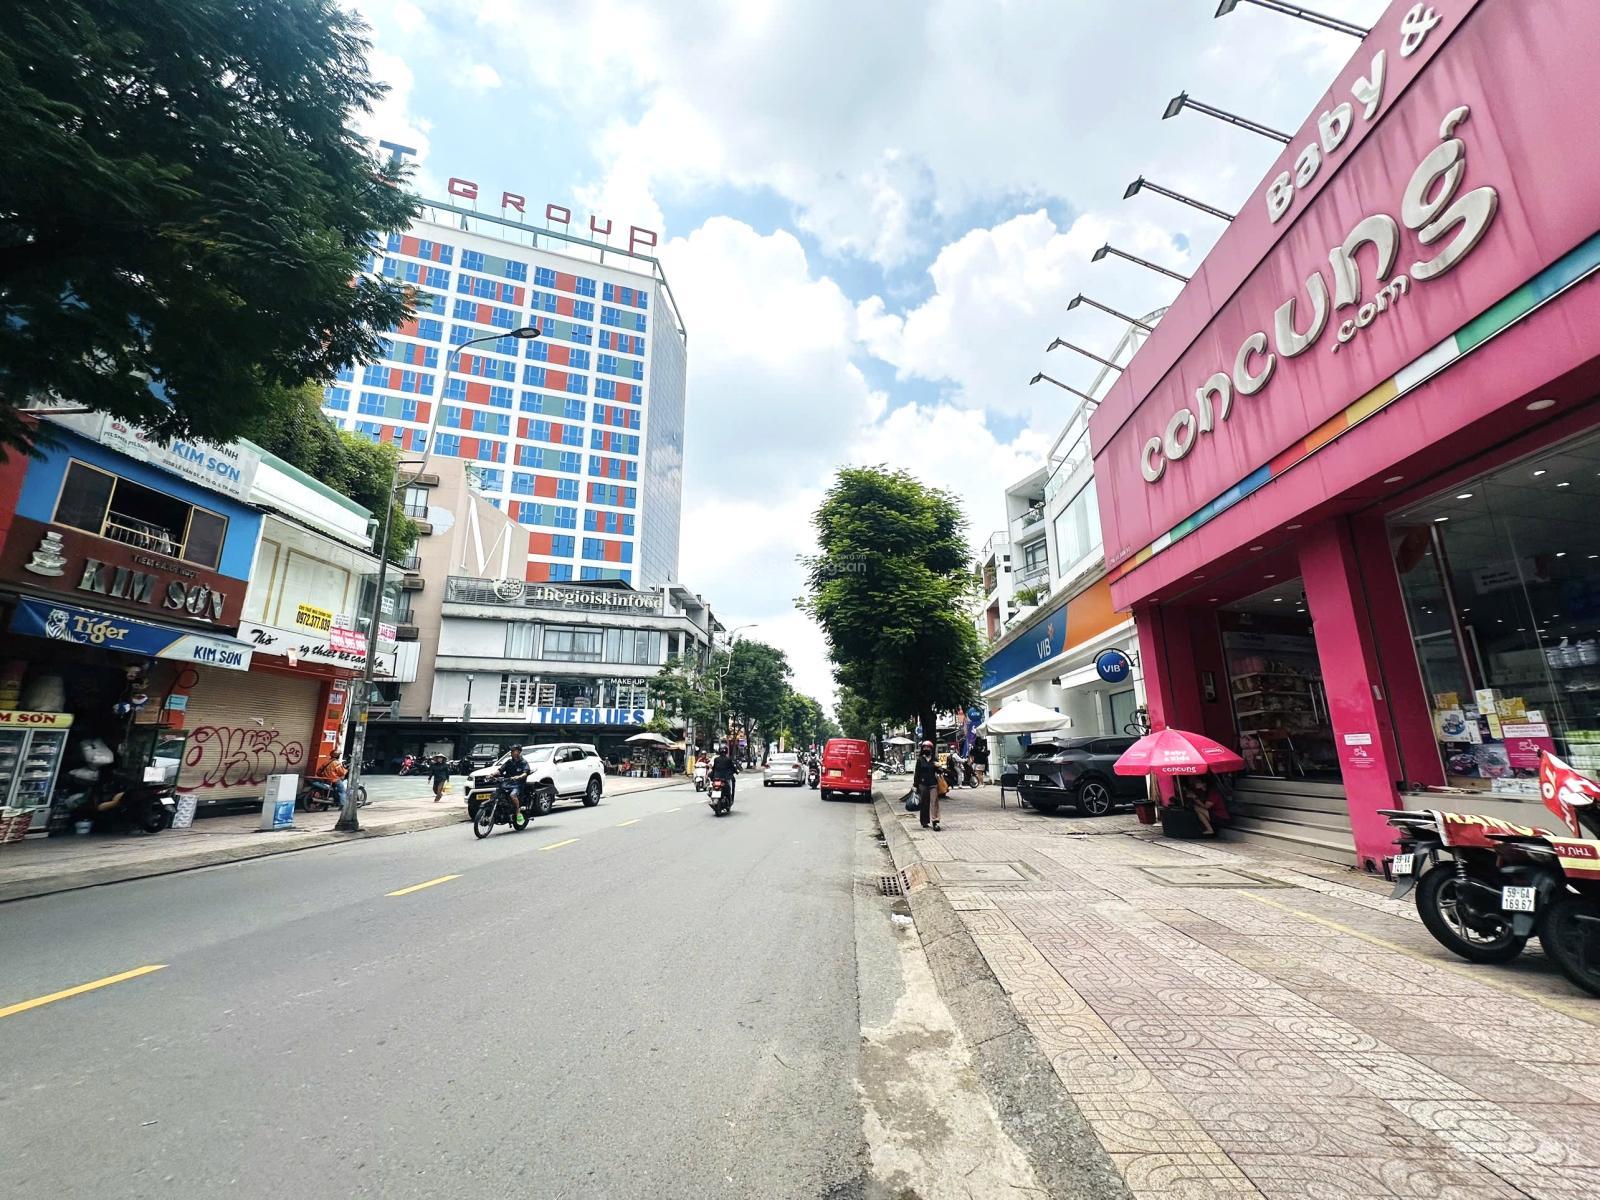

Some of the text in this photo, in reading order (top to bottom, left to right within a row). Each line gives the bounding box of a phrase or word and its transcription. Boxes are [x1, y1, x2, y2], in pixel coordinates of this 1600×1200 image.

[1266, 2, 1443, 225] Baby &
[447, 177, 658, 257] GROUP
[1140, 105, 1500, 485] concung
[1331, 274, 1410, 353] .com
[171, 440, 241, 482] KIM SƠN
[77, 557, 228, 620] KIM SƠN
[536, 587, 664, 609] thegioiskinfood
[73, 615, 129, 644] Tiger
[193, 645, 216, 663] KIM
[219, 649, 243, 667] SƠN
[1036, 640, 1051, 660] VIB
[1102, 663, 1122, 674] VIB
[17, 712, 57, 724] SƠN
[537, 708, 578, 725] THE
[1506, 888, 1531, 899] 59-GA
